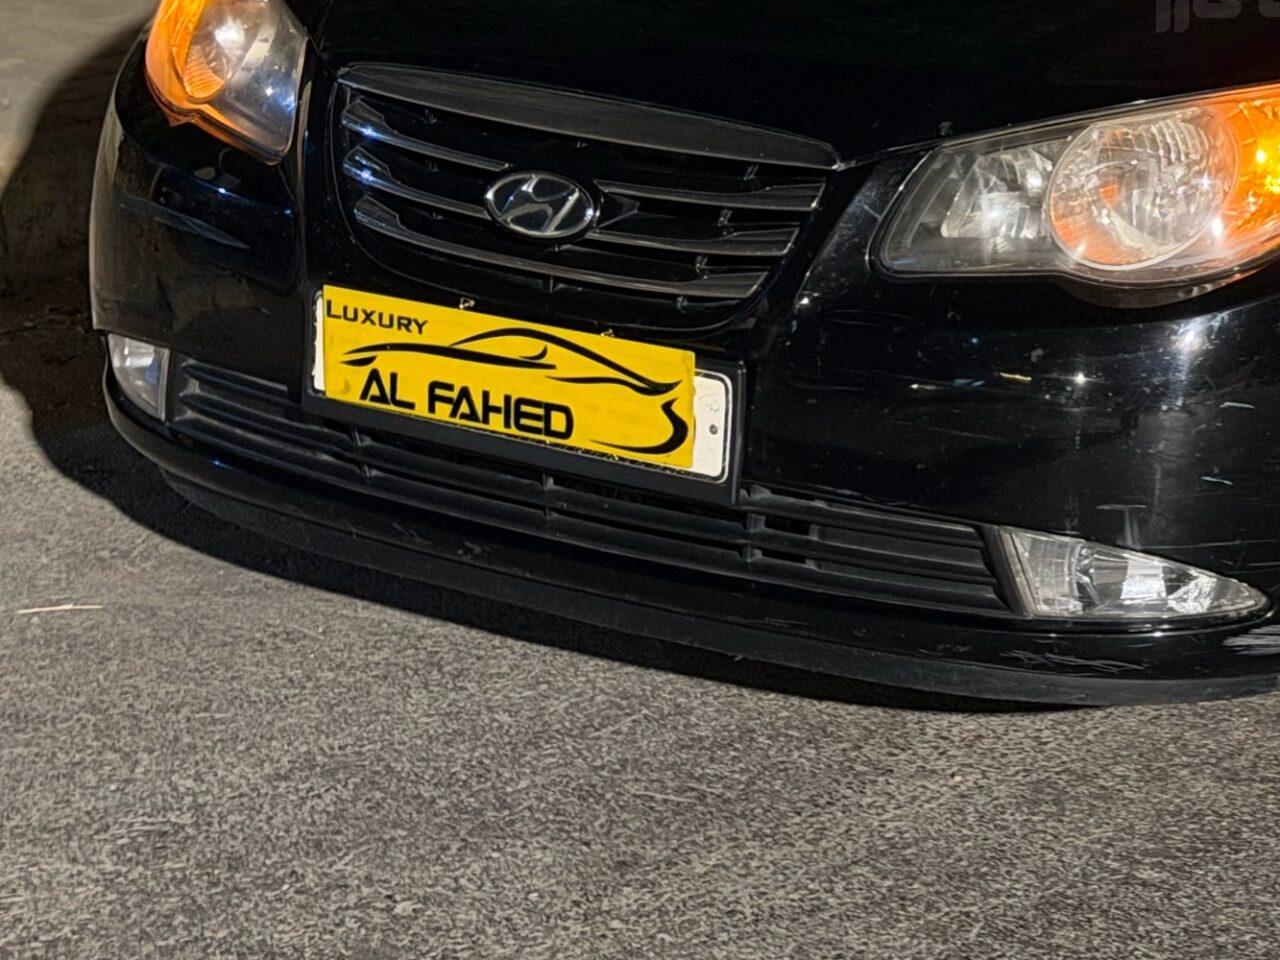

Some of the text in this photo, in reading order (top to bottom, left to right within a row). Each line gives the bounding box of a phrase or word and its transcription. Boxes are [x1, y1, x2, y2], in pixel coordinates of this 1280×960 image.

[326, 299, 428, 335] LUXURY
[359, 367, 575, 441] AL FAHED
